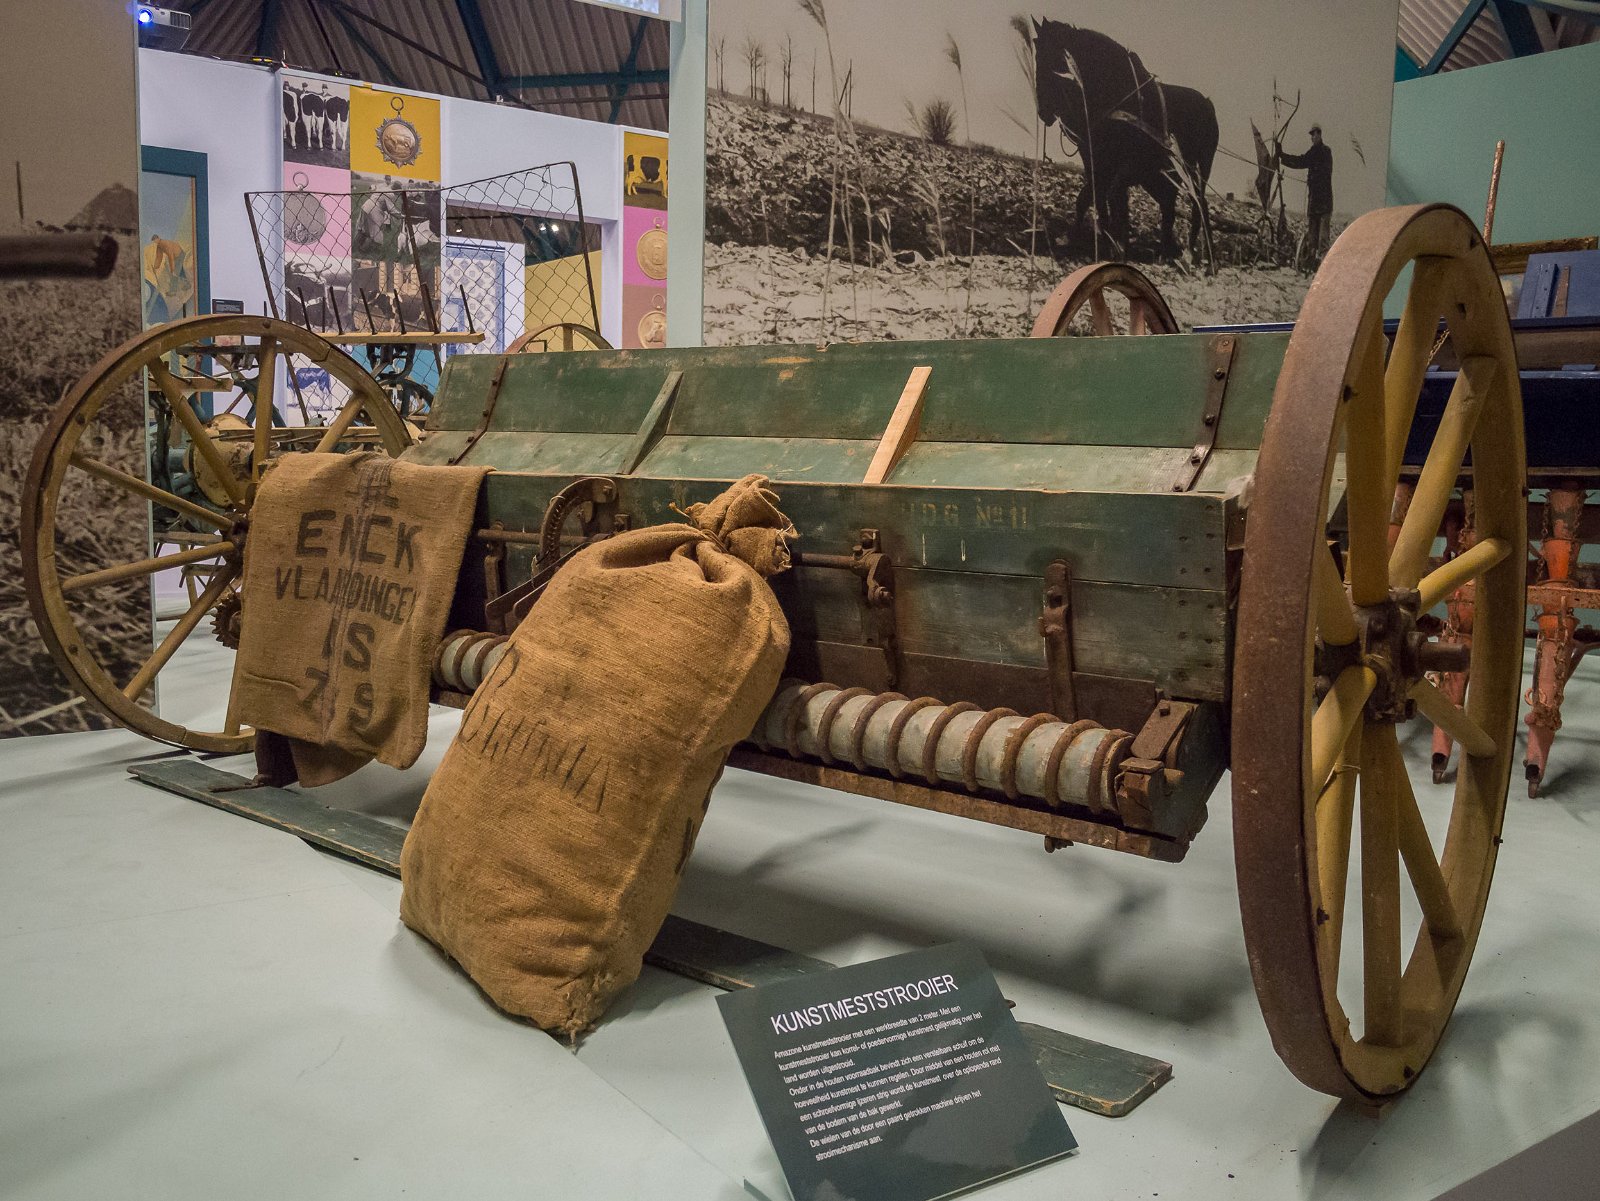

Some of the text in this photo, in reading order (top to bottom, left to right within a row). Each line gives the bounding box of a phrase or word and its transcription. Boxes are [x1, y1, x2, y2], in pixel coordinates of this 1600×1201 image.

[296, 509, 422, 573] ENCK
[771, 974, 959, 1035] KUNSTMESTSTROOIER
[774, 1047, 802, 1058] Amazone
[801, 1034, 851, 1051] kunstmeststrooier
[852, 1030, 864, 1038] met
[875, 1019, 908, 1032] werkbreedte
[923, 1011, 940, 1019] meter.
[939, 1007, 951, 1015] Met
[778, 1053, 829, 1071] kunstmeststrooier
[841, 1044, 860, 1054] korrel-
[860, 1041, 867, 1049] of
[867, 1033, 907, 1049] poedervormige
[906, 1024, 934, 1036] kunstmest
[934, 1018, 962, 1031] gelijkmatig
[972, 1011, 982, 1019] het
[789, 1086, 808, 1096] Onder
[823, 1076, 844, 1086] houten
[845, 1065, 880, 1080] voorraadbak
[879, 1060, 900, 1071] bevindt
[900, 1057, 912, 1065] zich
[923, 1046, 952, 1058] verstelbare
[952, 1040, 968, 1050] schuif
[783, 1059, 855, 1083] land worden uitgestrooid.
[793, 1092, 830, 1108] hoeveelheid
[830, 1085, 860, 1098] kunstmest
[866, 1078, 888, 1087] kunnen
[888, 1071, 909, 1082] regelen.
[910, 1067, 924, 1075] Door
[925, 1061, 943, 1071] middel
[963, 1050, 982, 1060] houten
[982, 1047, 990, 1055] rol
[989, 1044, 1000, 1052] met
[800, 1113, 812, 1121] een
[812, 1100, 856, 1118] schroefvormige
[856, 1095, 876, 1106] ijzeren
[876, 1091, 889, 1099] strip
[889, 1085, 905, 1095] wordt
[905, 1083, 913, 1091] de
[912, 1075, 941, 1088] kunstmest
[942, 1071, 954, 1080] over
[962, 1061, 989, 1074] oplopende
[989, 1057, 1001, 1065] rand
[804, 1126, 817, 1134] van
[817, 1123, 825, 1131] de
[825, 1117, 847, 1128] bodem
[847, 1114, 858, 1122] van
[866, 1107, 878, 1116] bak
[879, 1100, 902, 1114] gewerkt.
[809, 1090, 981, 1147] De wielen van de door een paard getrokken machine drijven het
[815, 1135, 882, 1161] strooimechanisme aan.
